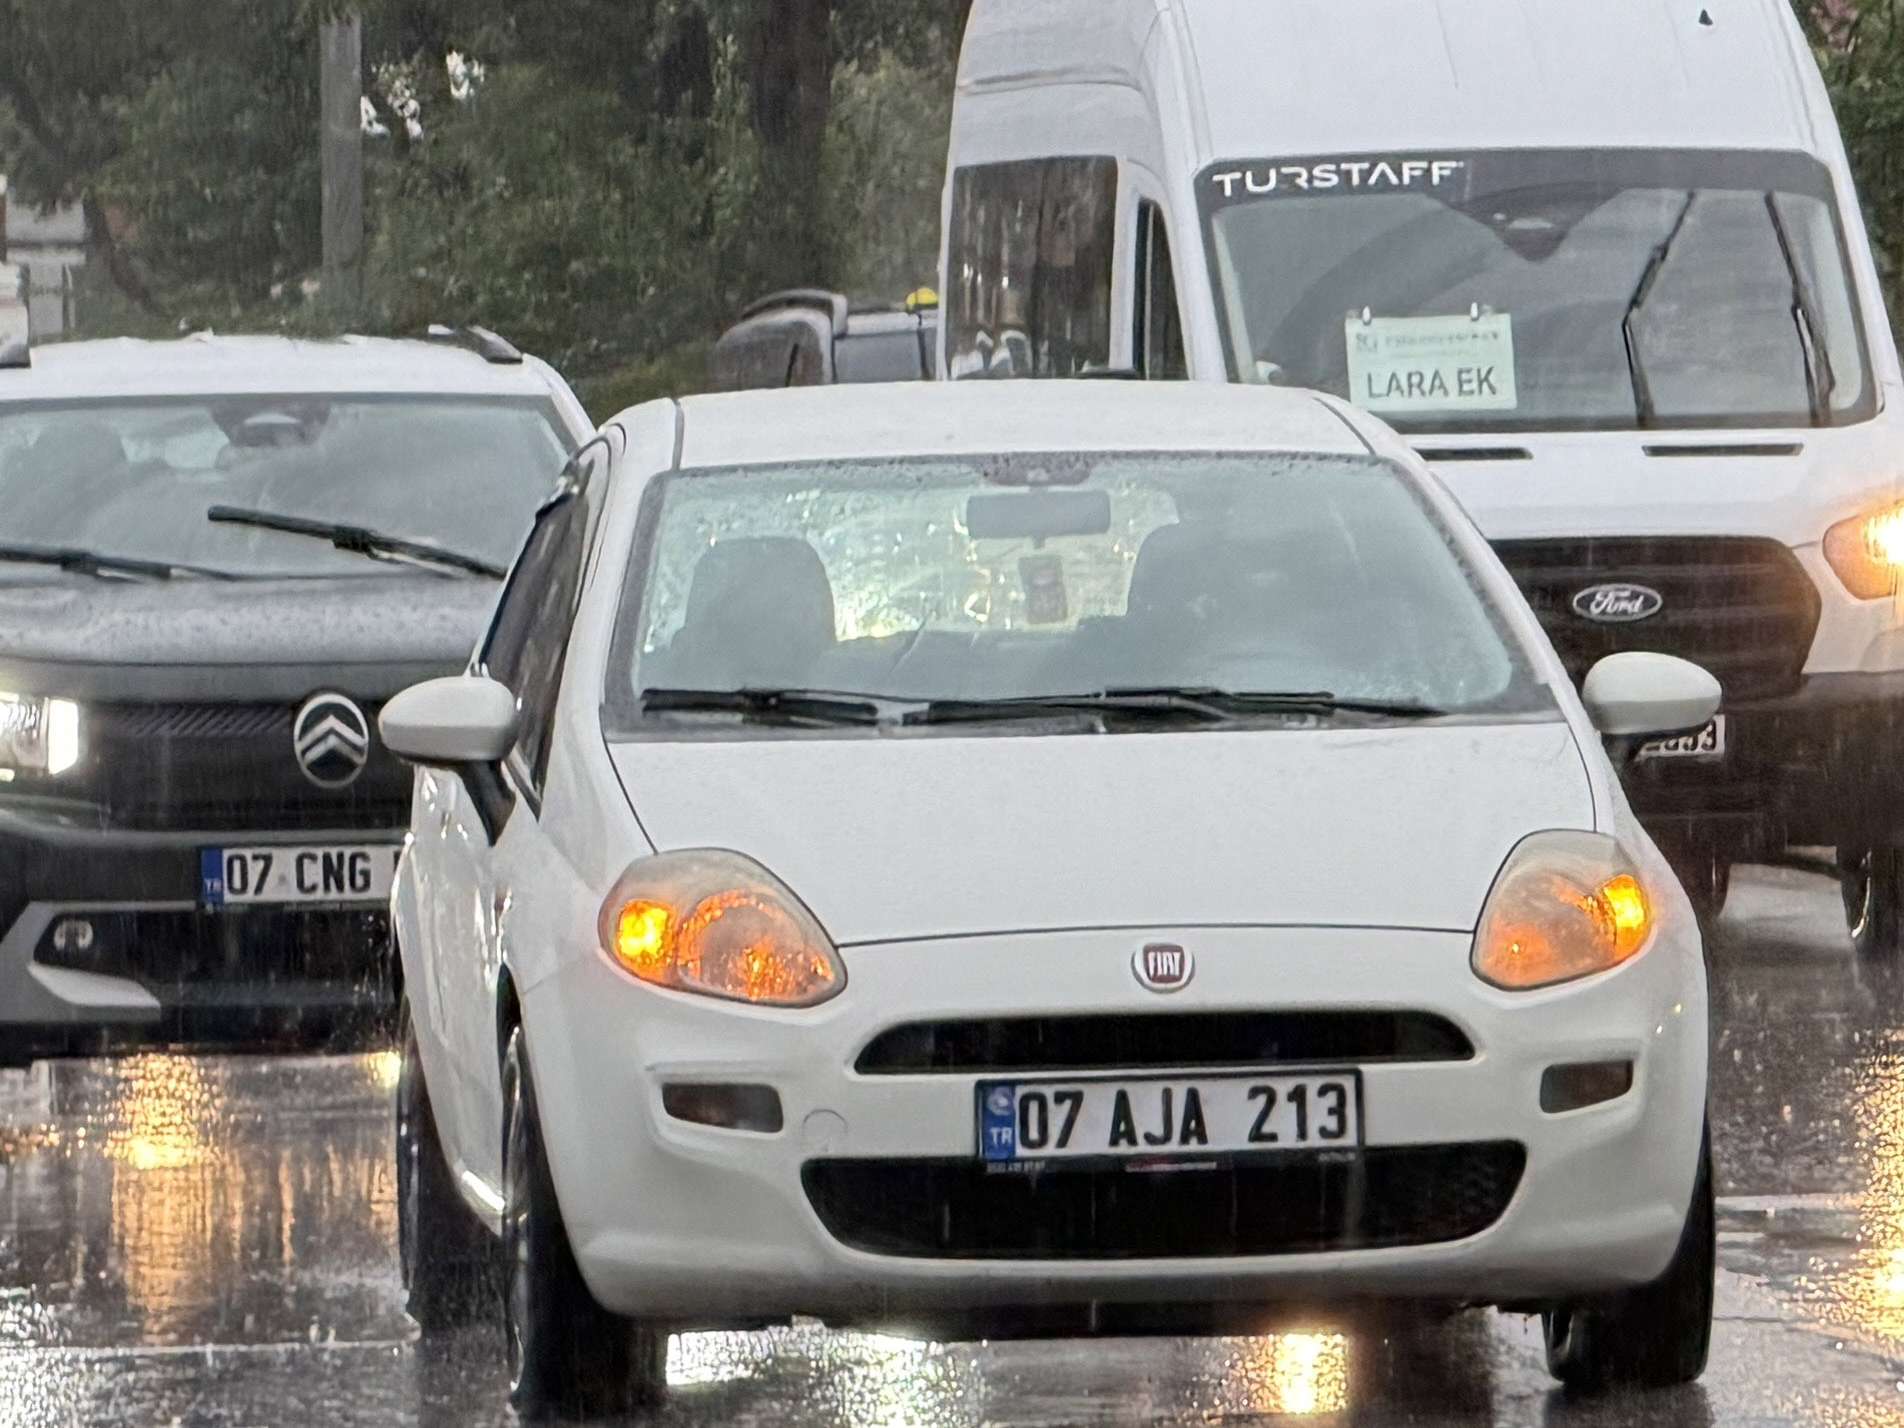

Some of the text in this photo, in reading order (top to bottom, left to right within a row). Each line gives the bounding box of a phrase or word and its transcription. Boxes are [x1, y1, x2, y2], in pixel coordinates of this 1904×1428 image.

[1212, 161, 1456, 197] TURSTAFF
[1366, 366, 1497, 398] LARA EK
[1590, 590, 1644, 615] Ford
[226, 852, 273, 896] 07
[295, 851, 372, 894] CNG
[1148, 951, 1181, 977] FIAT
[1019, 1082, 1347, 1149] 07 AJA 213
[989, 1127, 1013, 1145] TR
